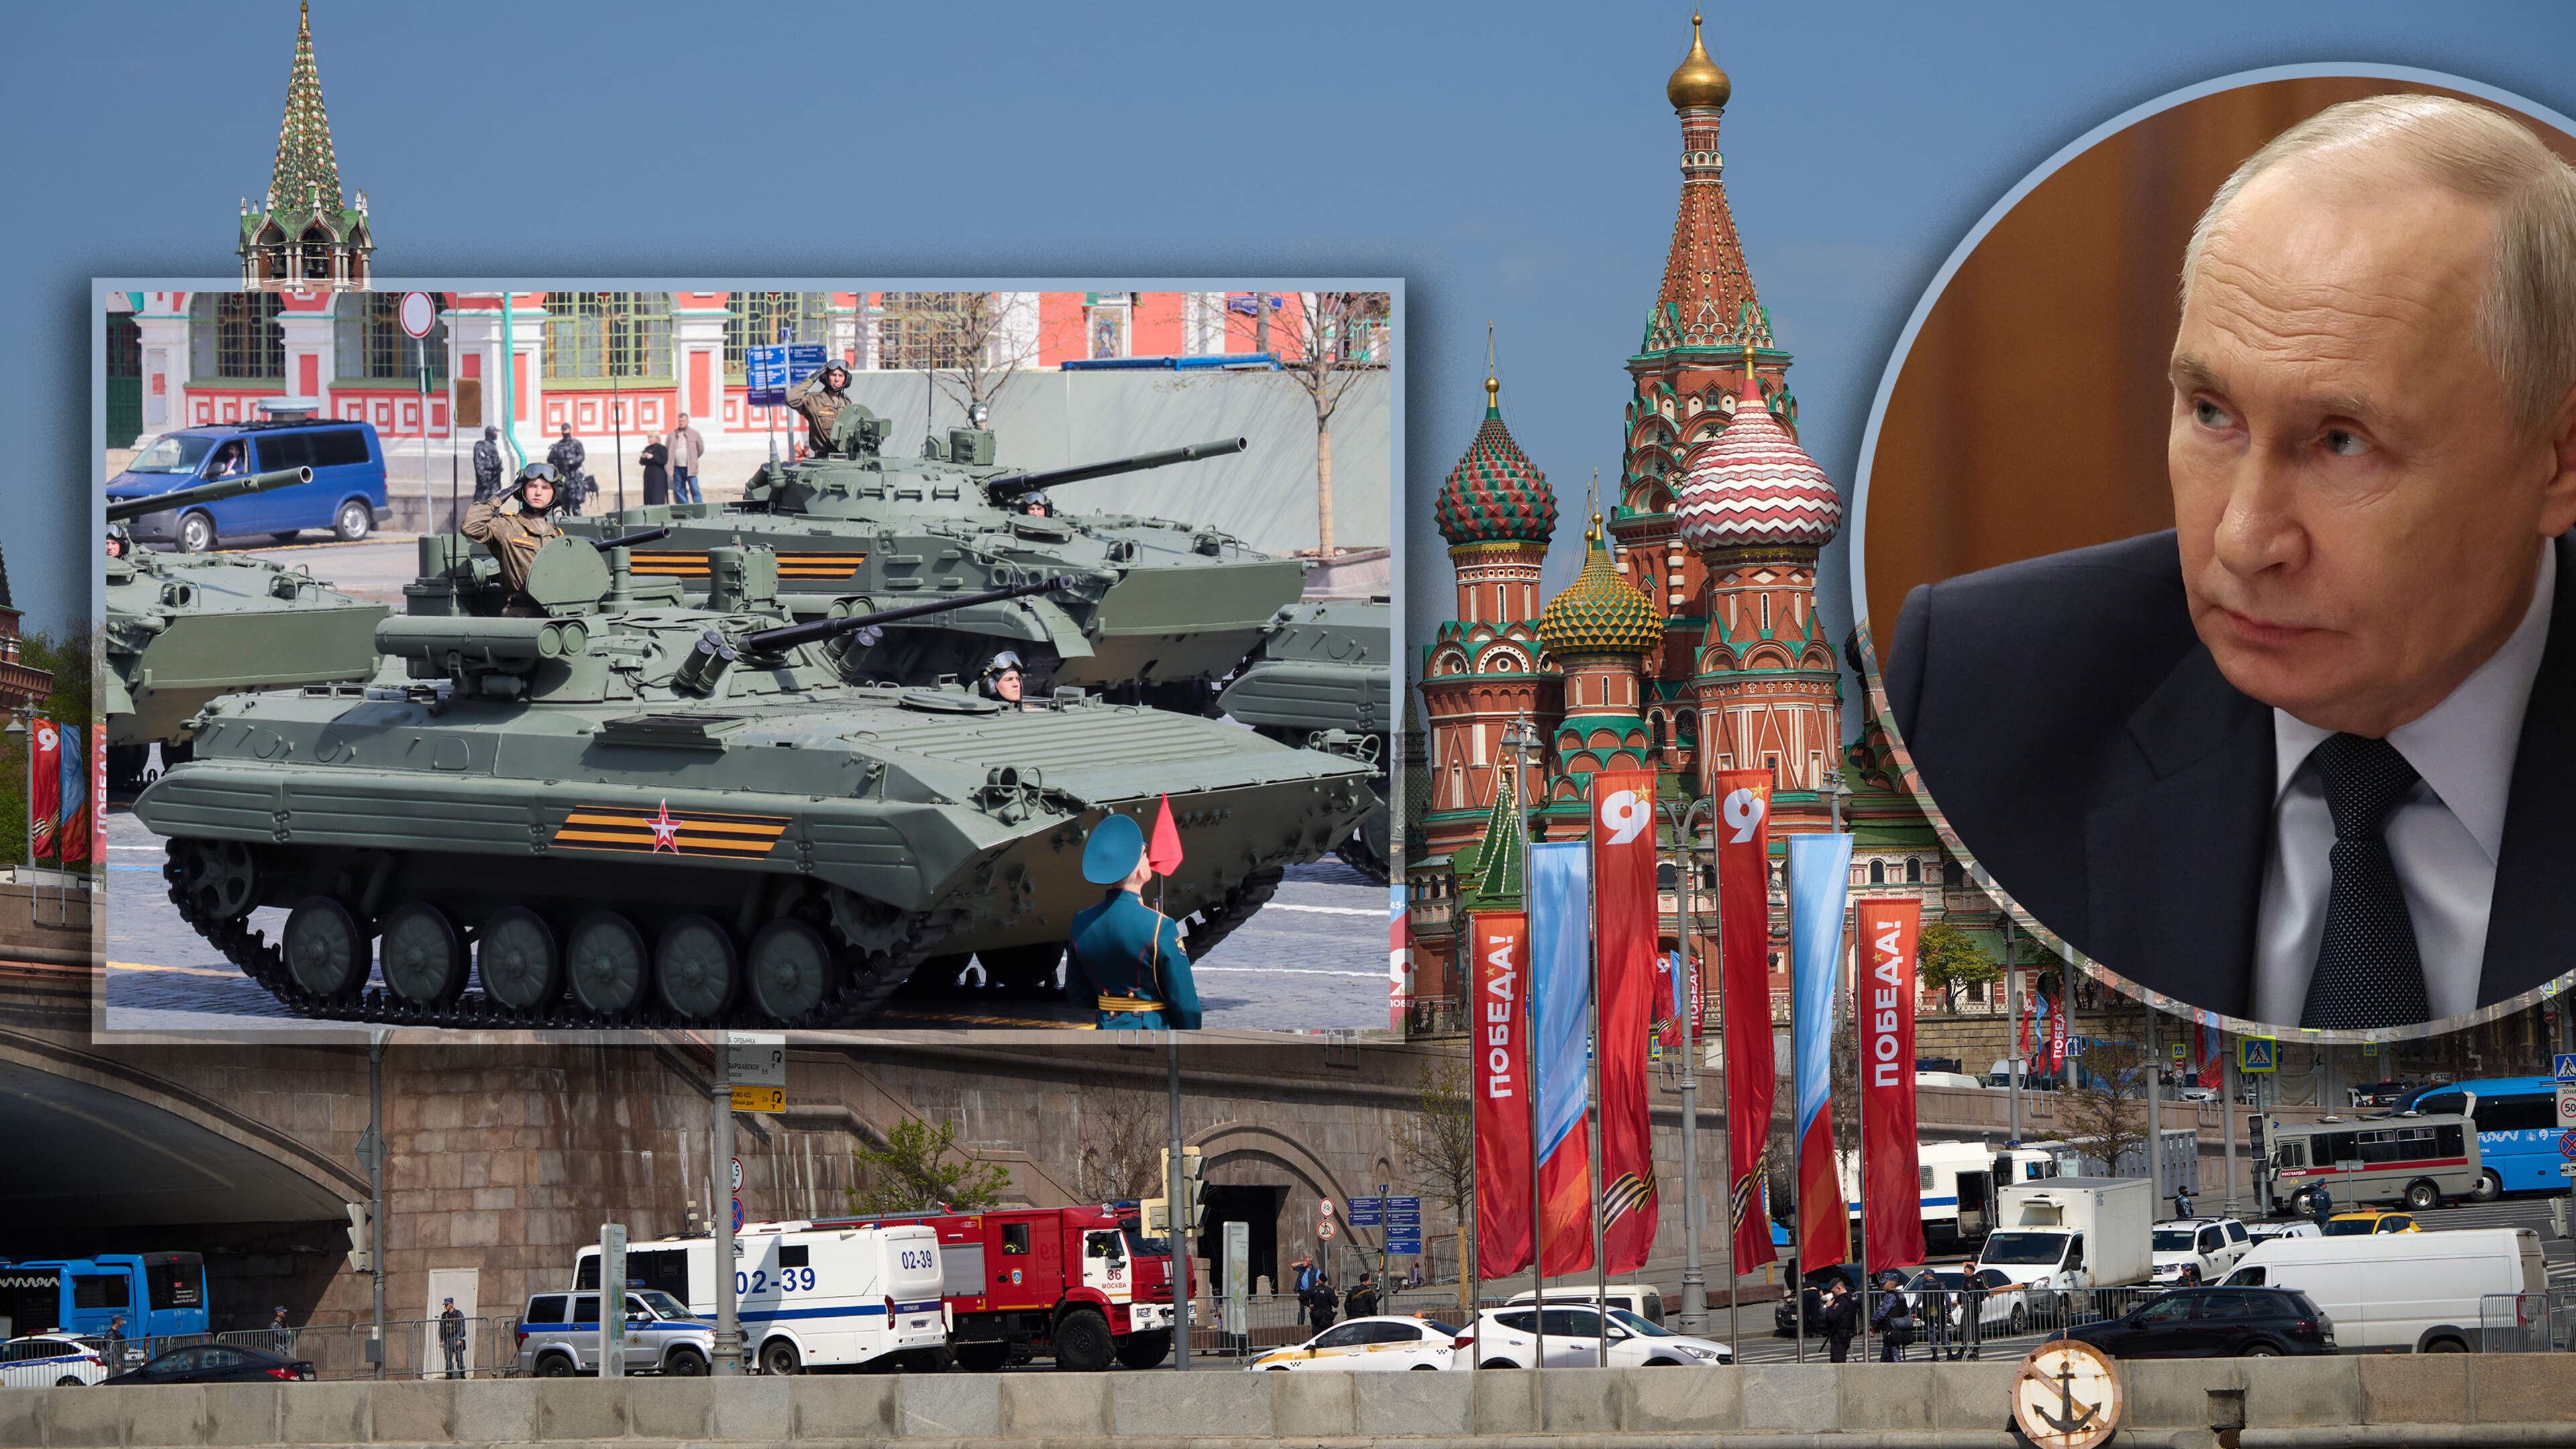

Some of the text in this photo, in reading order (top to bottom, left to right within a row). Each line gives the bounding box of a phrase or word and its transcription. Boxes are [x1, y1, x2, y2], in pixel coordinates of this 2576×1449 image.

[38, 728, 59, 751] 9
[1601, 790, 1652, 845] 9
[1723, 788, 1765, 844] 9
[1657, 957, 1670, 973] 9
[1690, 960, 1699, 1026] ПОБЕДА
[1875, 920, 1904, 1087] ПОБЕДА!
[1487, 935, 1517, 1099] ПОБЕДА!
[2565, 1104, 2576, 1112] 50
[902, 1250, 933, 1270] 02-39
[736, 1267, 816, 1295] 02-39
[1107, 1269, 1122, 1281] 36
